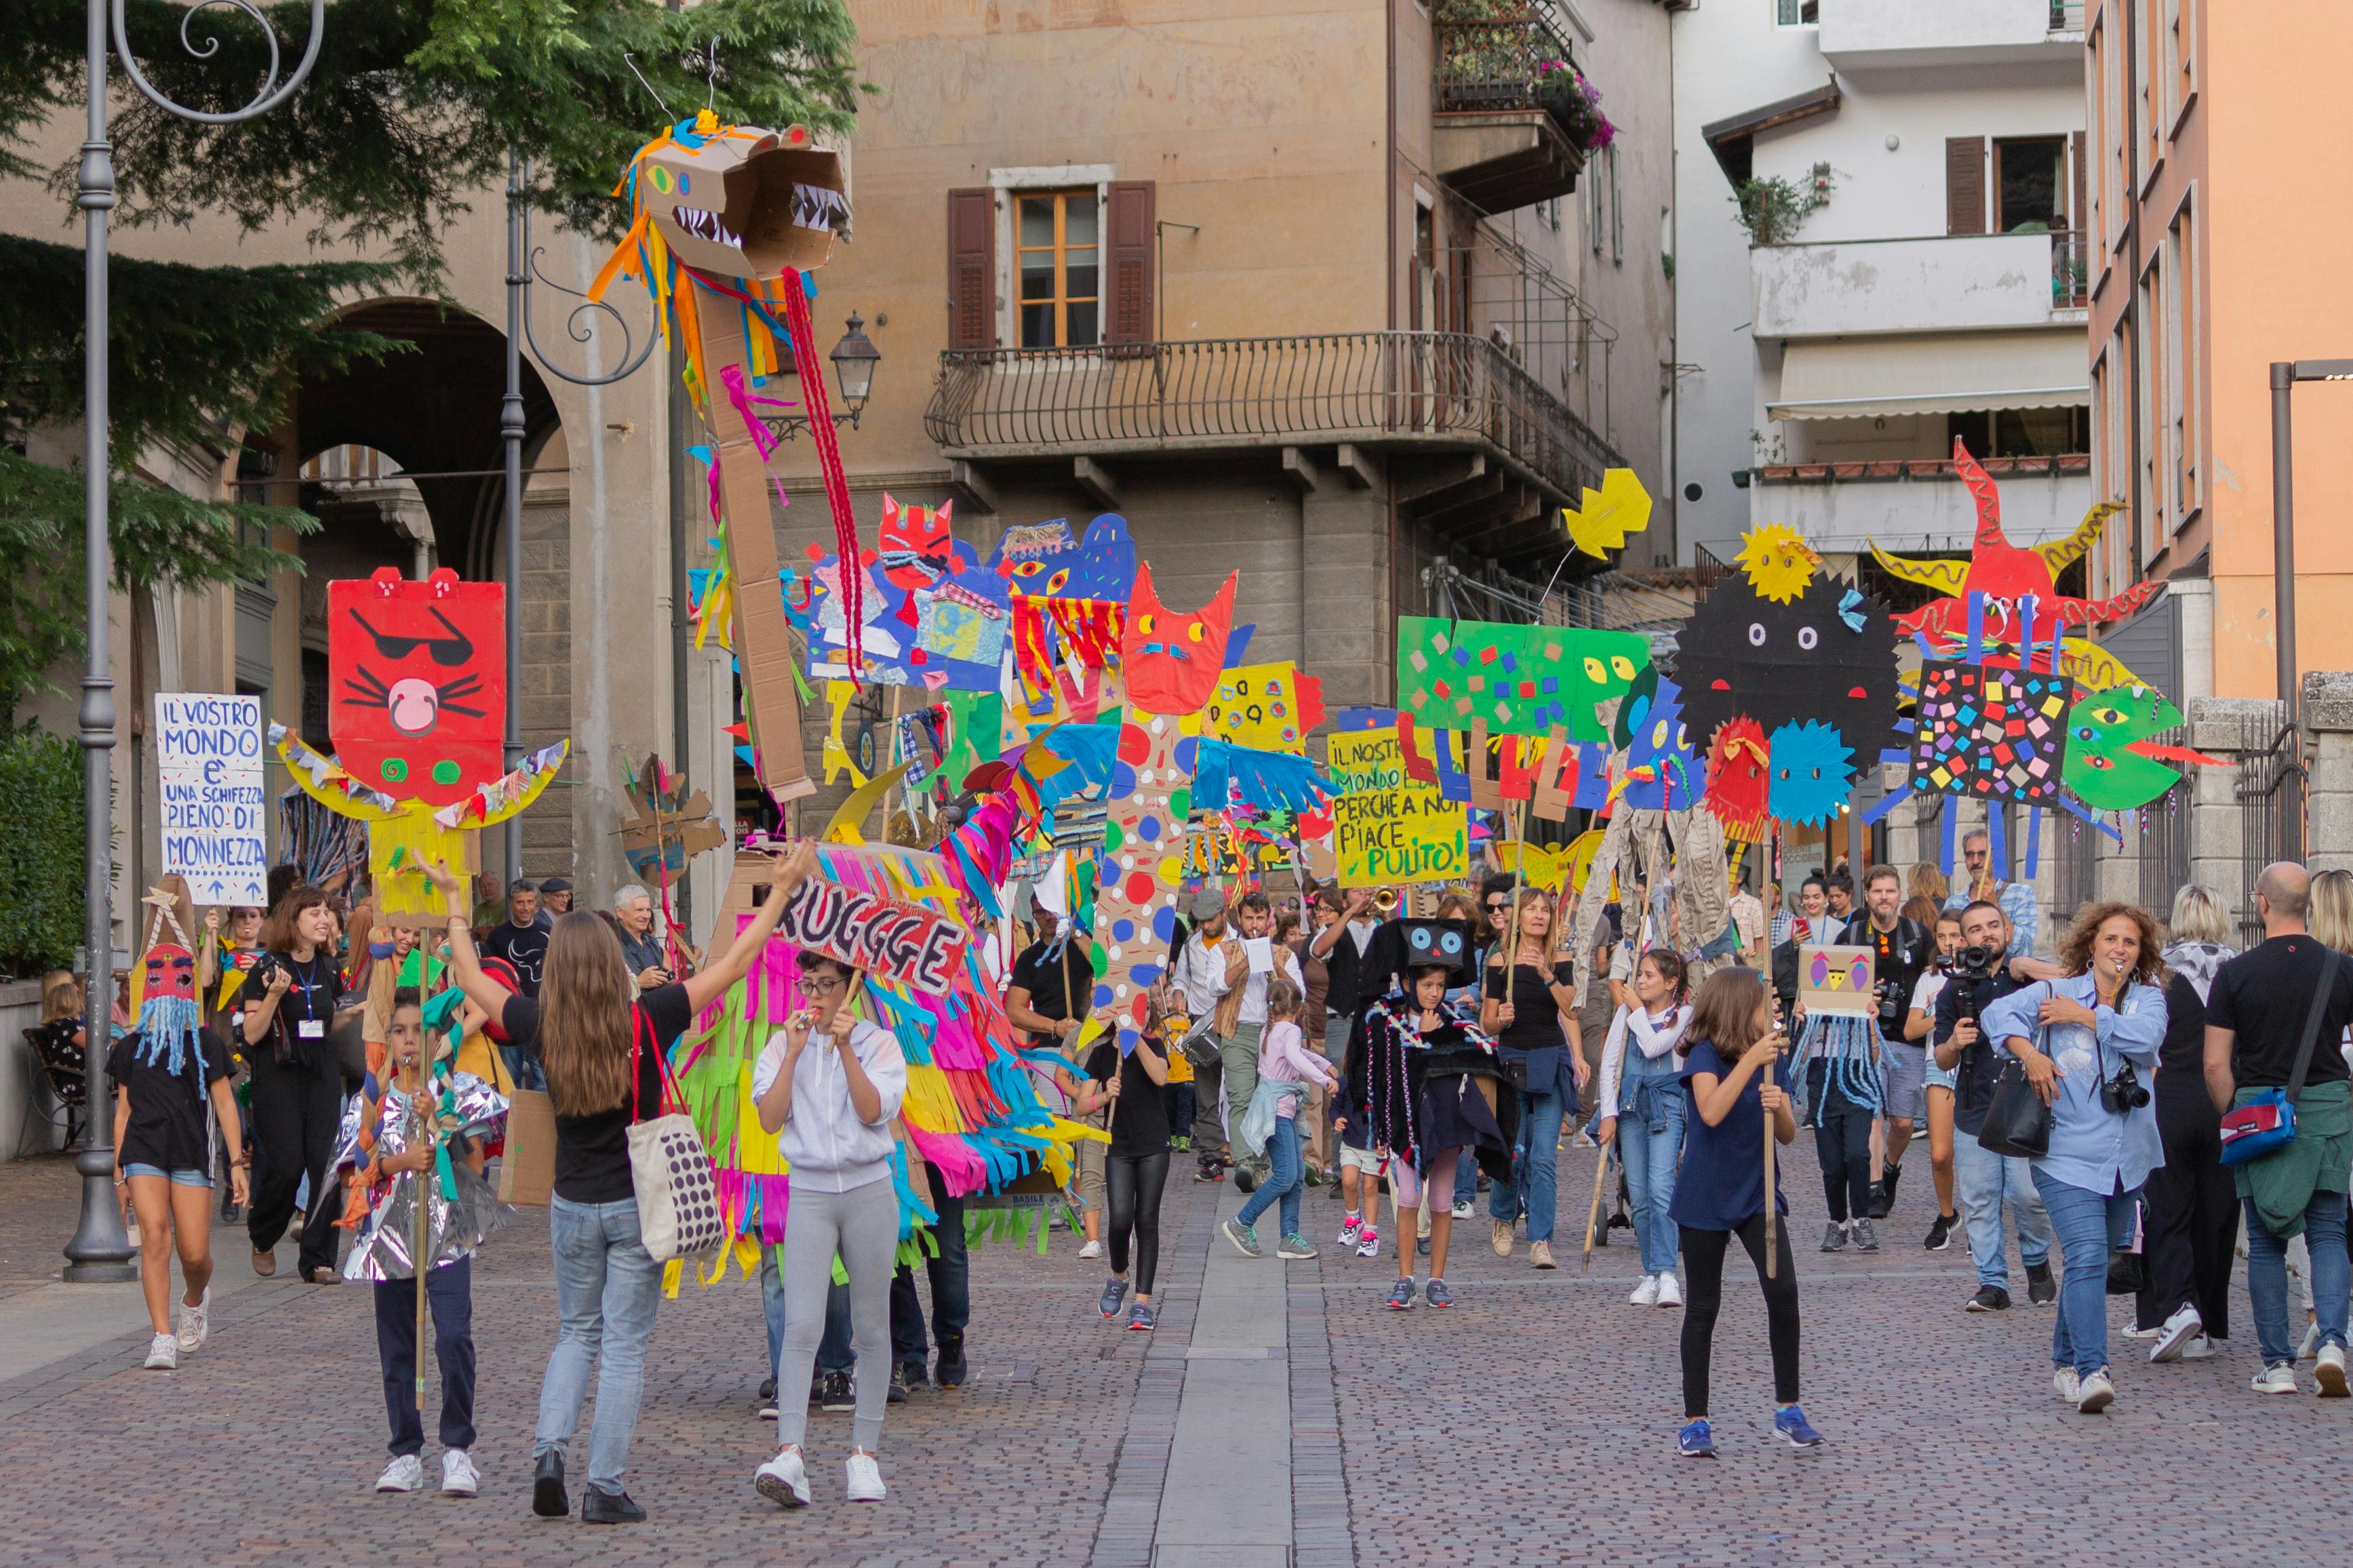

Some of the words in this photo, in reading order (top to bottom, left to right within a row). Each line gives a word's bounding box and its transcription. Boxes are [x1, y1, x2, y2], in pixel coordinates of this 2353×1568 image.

[163, 702, 179, 724] IL
[183, 700, 258, 727] VOSTRO
[165, 728, 258, 757] MONDO
[1336, 768, 1400, 792] MONDO
[166, 784, 198, 801] UNA
[203, 786, 264, 805] SCHIFEZZA
[1334, 789, 1398, 822] PERCHÉ
[1402, 795, 1417, 815] A
[168, 804, 224, 828] PIENO
[234, 807, 254, 829] DI
[167, 835, 266, 868] MONNEZZA
[1783, 852, 1823, 864] OCCIDENTE
[1013, 1194, 1045, 1203] BASILE
